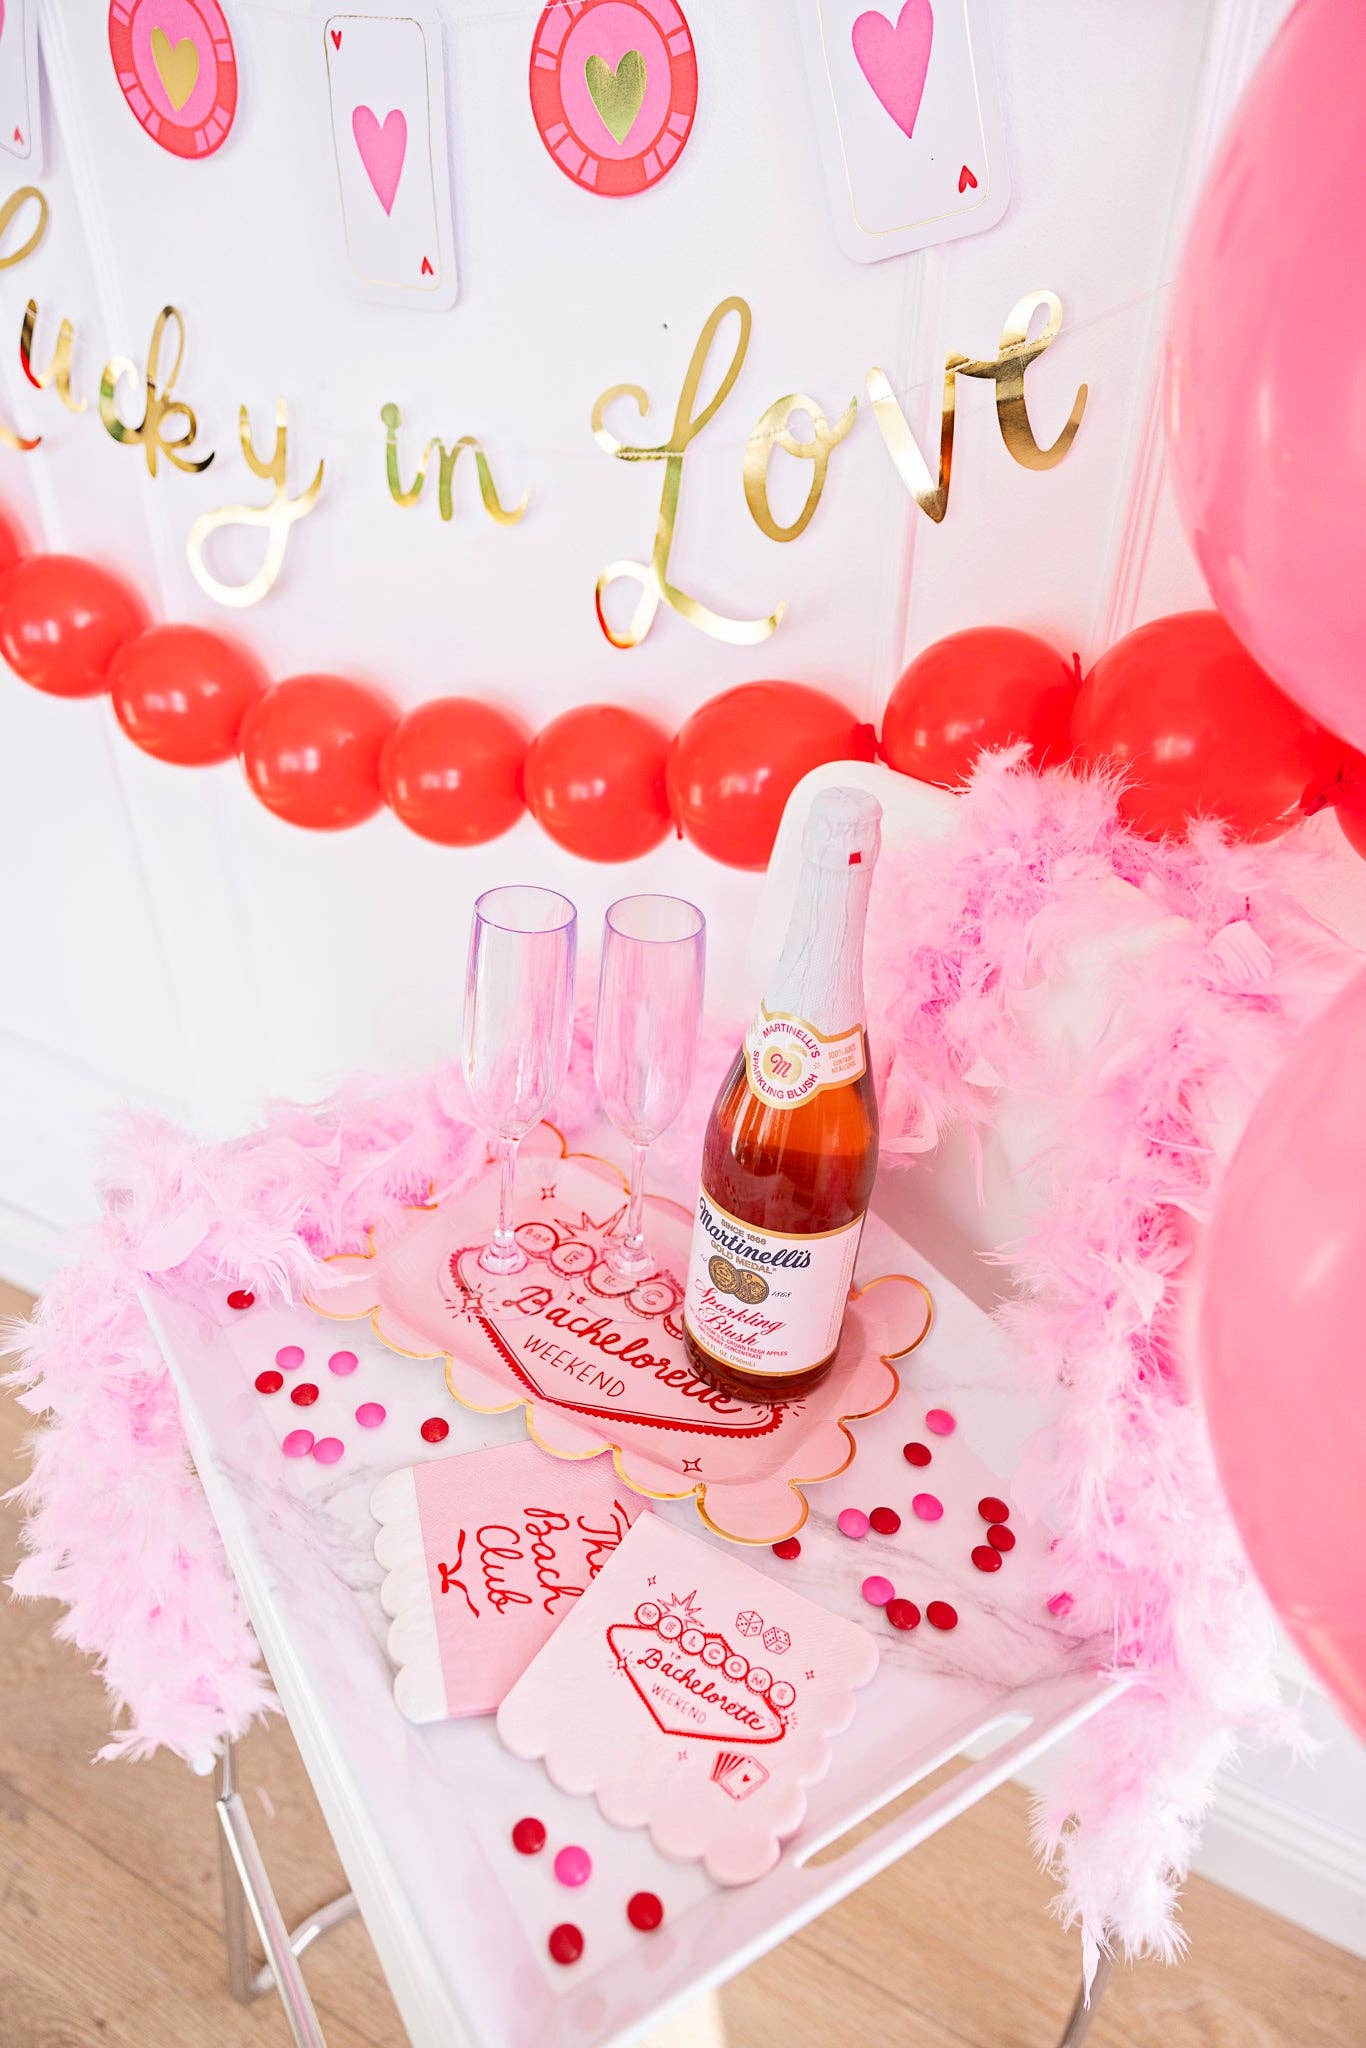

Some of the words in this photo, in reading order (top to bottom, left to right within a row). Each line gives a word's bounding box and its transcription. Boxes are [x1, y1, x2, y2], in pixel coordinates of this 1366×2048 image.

[381, 403, 530, 525] in
[591, 290, 1088, 650] Love
[763, 1023, 820, 1058] MARTINELLI'S
[752, 1050, 785, 1099] SPARKLING
[787, 1074, 818, 1099] BLUSH
[700, 1196, 811, 1269] Martinelli's
[711, 1239, 734, 1260] GOLD
[721, 1218, 745, 1238] SINCE
[747, 1232, 767, 1245] 1868
[694, 1279, 787, 1335] Sparkling
[698, 1308, 759, 1346] Blush
[524, 1334, 625, 1398] WEEKEND
[724, 1344, 762, 1360] CONCENTRATE
[747, 1345, 766, 1355] FRESH
[476, 1525, 532, 1615] Club
[523, 1507, 585, 1615] Bach
[638, 1648, 765, 1731] Bachelorette
[651, 1683, 707, 1724] WEEKEND
